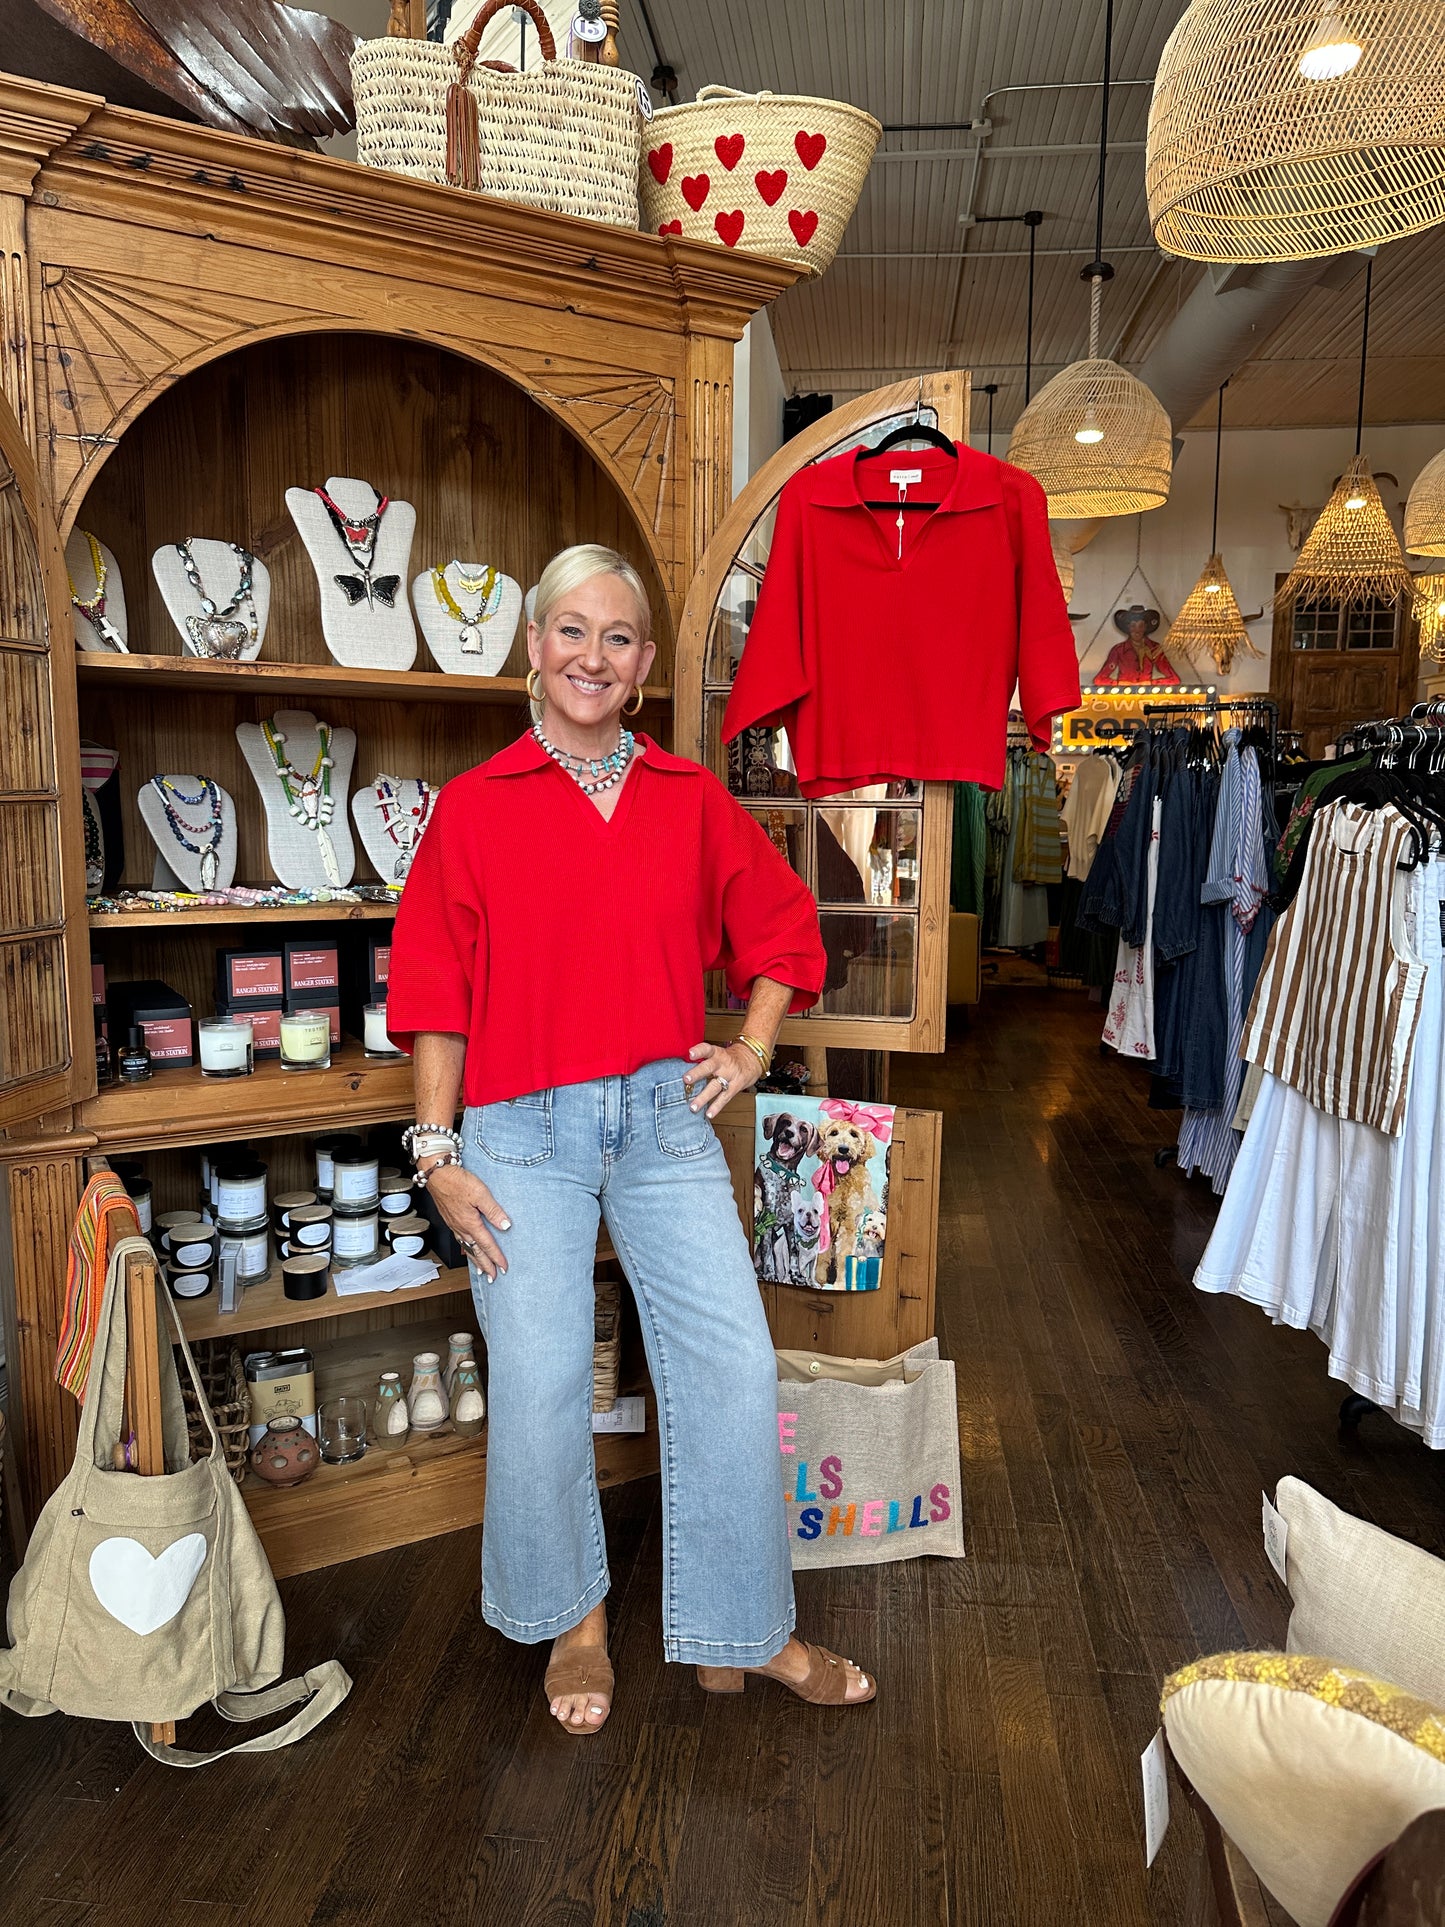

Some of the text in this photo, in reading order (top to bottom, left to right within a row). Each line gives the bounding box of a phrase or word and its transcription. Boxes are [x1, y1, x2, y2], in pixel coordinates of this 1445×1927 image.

[294, 978, 335, 987] RANGER STATION
[236, 986, 258, 994] RANGER
[257, 985, 279, 993] STATION
[165, 1048, 188, 1056] STATION
[783, 1455, 843, 1502] LS
[787, 1483, 951, 1541] SHELLS
